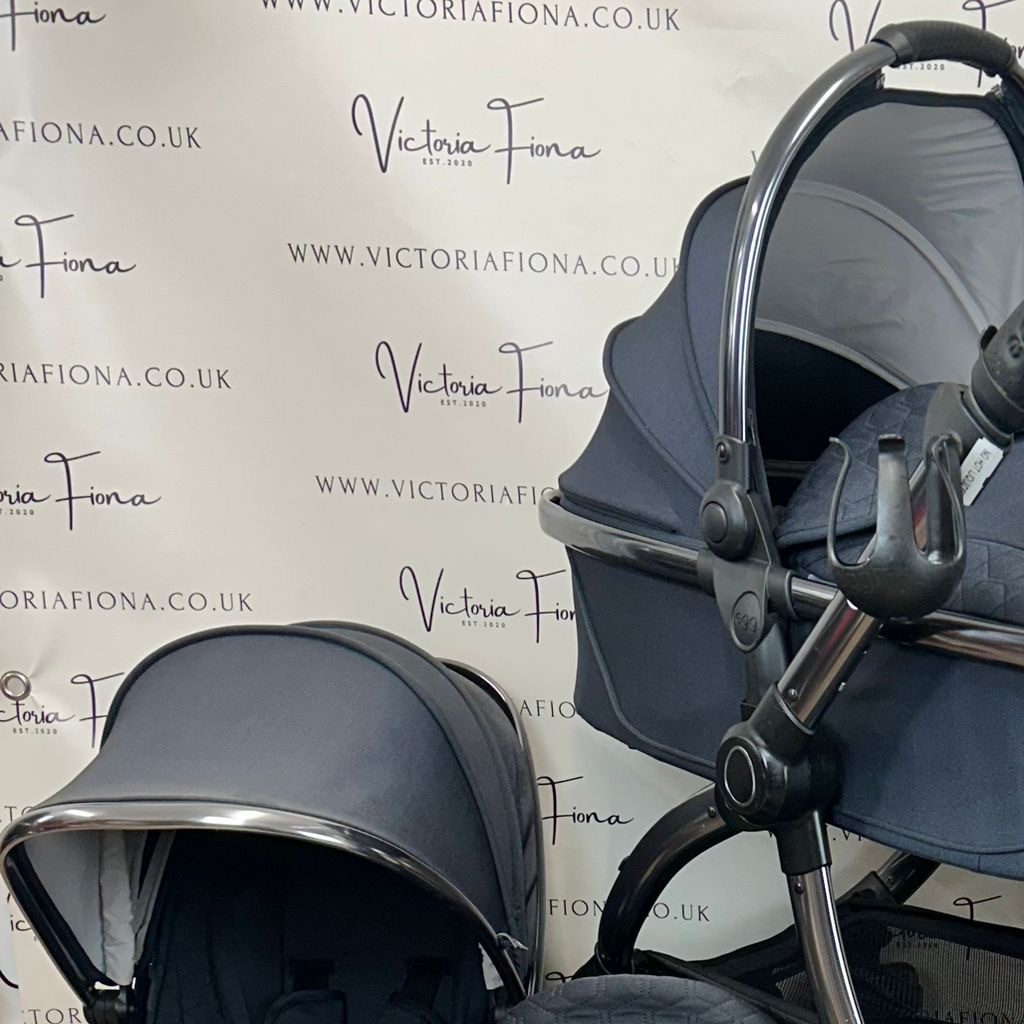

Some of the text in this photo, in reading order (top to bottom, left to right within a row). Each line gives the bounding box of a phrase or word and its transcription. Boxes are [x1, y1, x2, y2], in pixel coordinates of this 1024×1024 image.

[351, 94, 602, 185] Victoria Fiona
[422, 157, 473, 167] EST.2020
[14, 212, 138, 300] Fiona
[375, 341, 610, 424] Victoria Fiona
[43, 450, 163, 532] Fiona
[315, 475, 555, 506] WWW.VICTORIAFI
[399, 566, 521, 632] Victoria
[537, 775, 634, 846] Fiona
